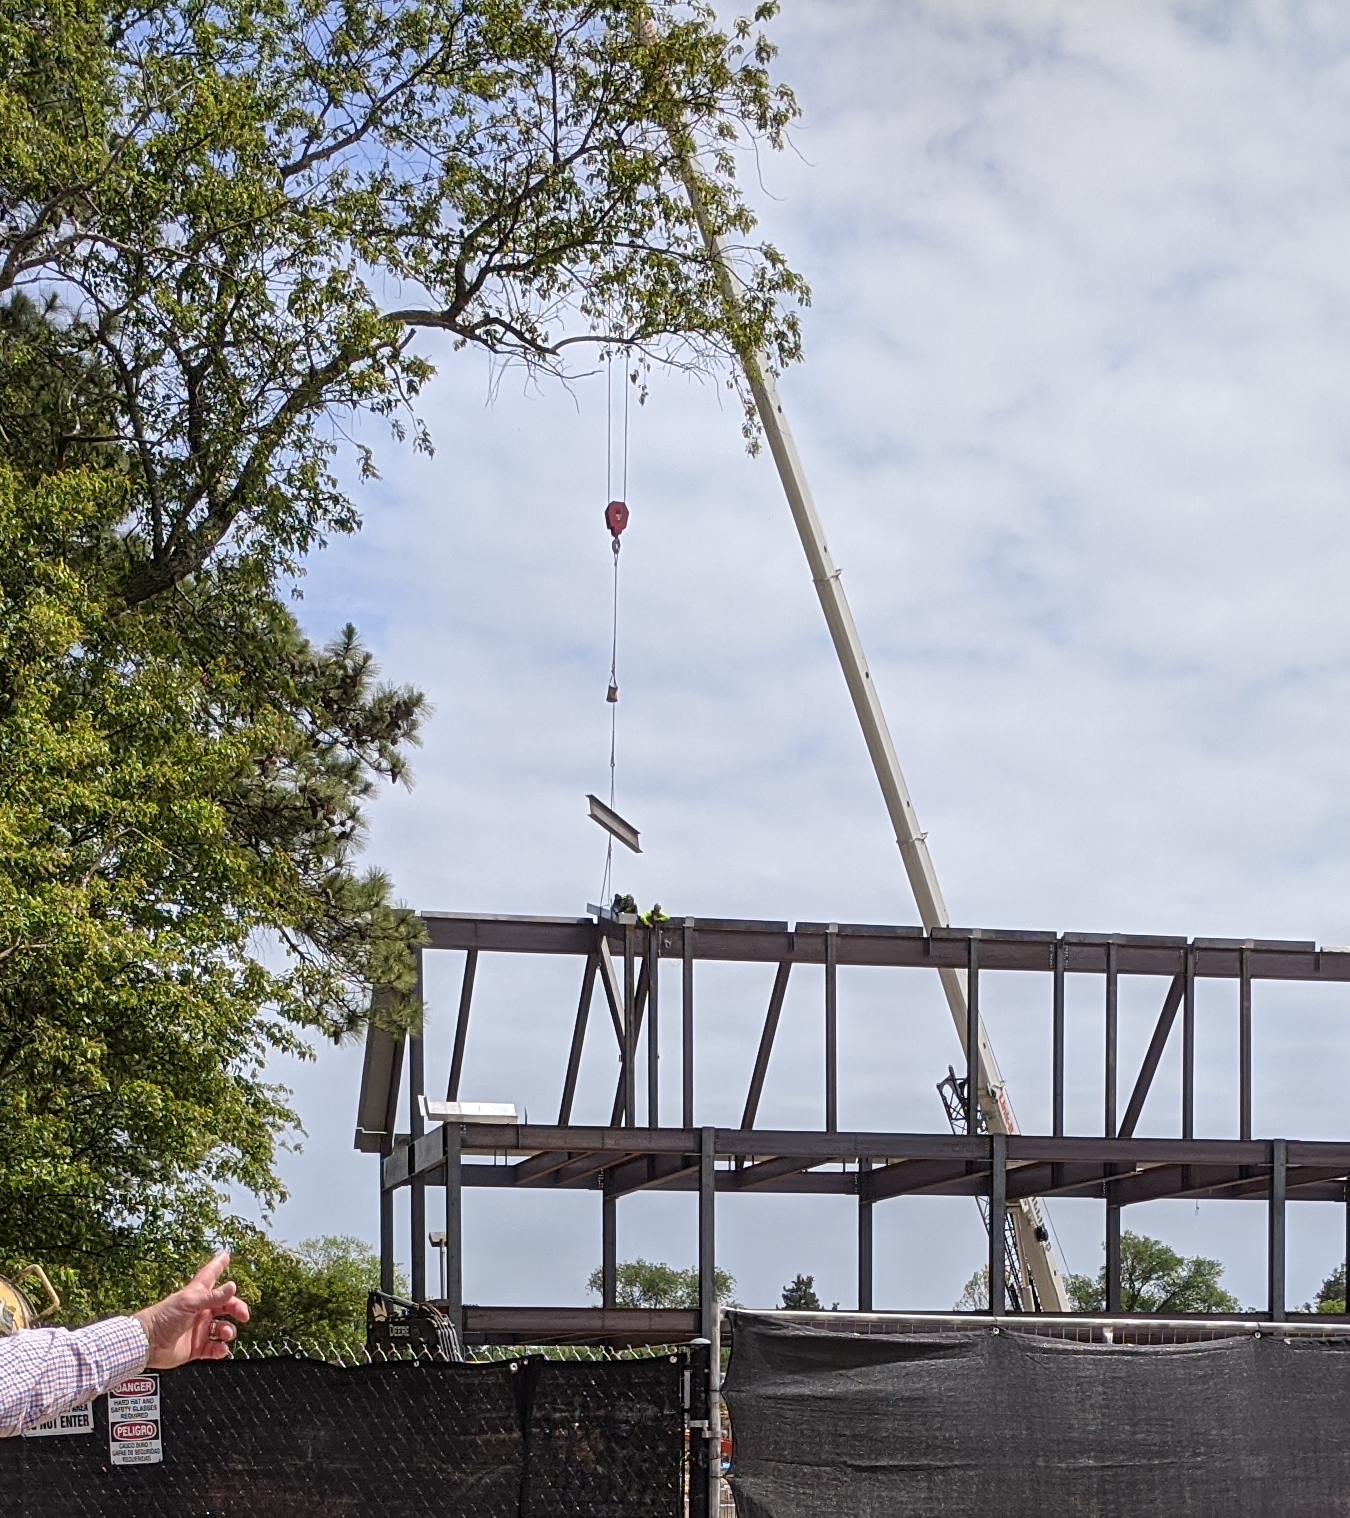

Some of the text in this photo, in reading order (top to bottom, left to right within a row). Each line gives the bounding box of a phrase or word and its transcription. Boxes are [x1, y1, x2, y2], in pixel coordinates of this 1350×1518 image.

[389, 1323, 410, 1337] DEERE
[60, 1414, 89, 1429] ENTER
[117, 1424, 154, 1437] PELIGRO
